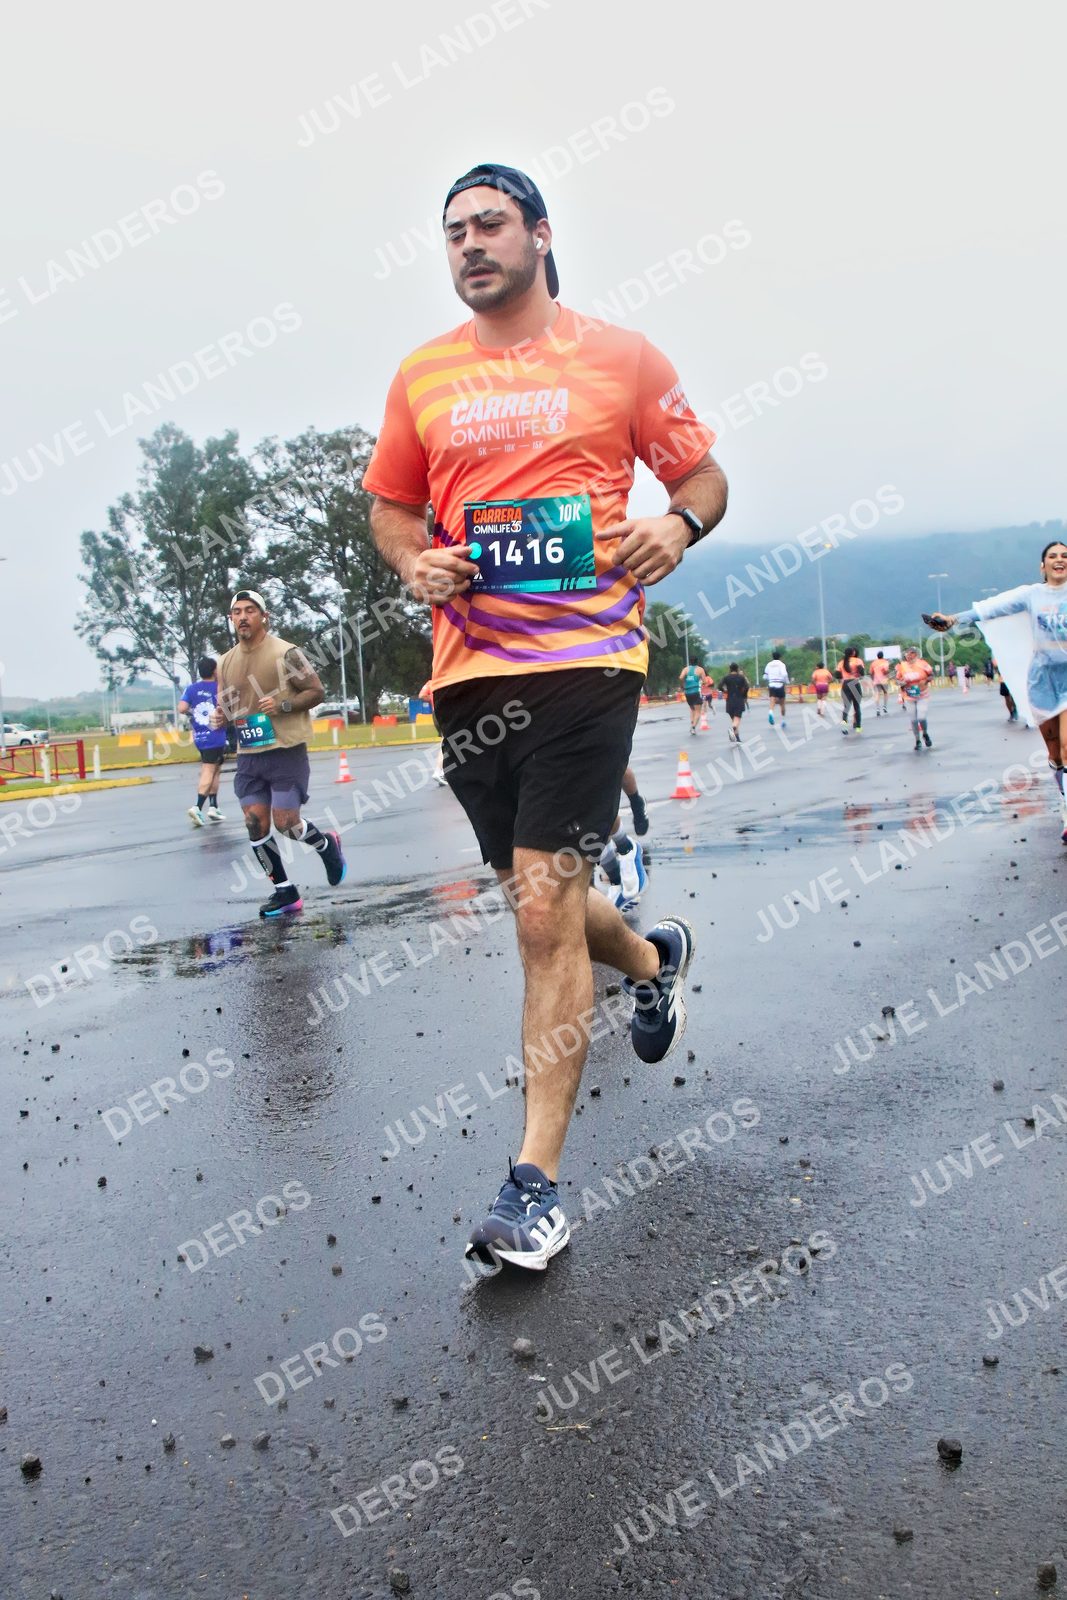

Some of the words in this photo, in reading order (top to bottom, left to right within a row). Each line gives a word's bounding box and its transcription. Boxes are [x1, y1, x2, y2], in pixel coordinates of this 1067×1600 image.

[451, 388, 568, 426] CARRERA
[473, 508, 522, 524] CARRERA
[559, 503, 582, 522] 10K
[488, 538, 564, 566] 1416
[241, 727, 264, 739] 1519
